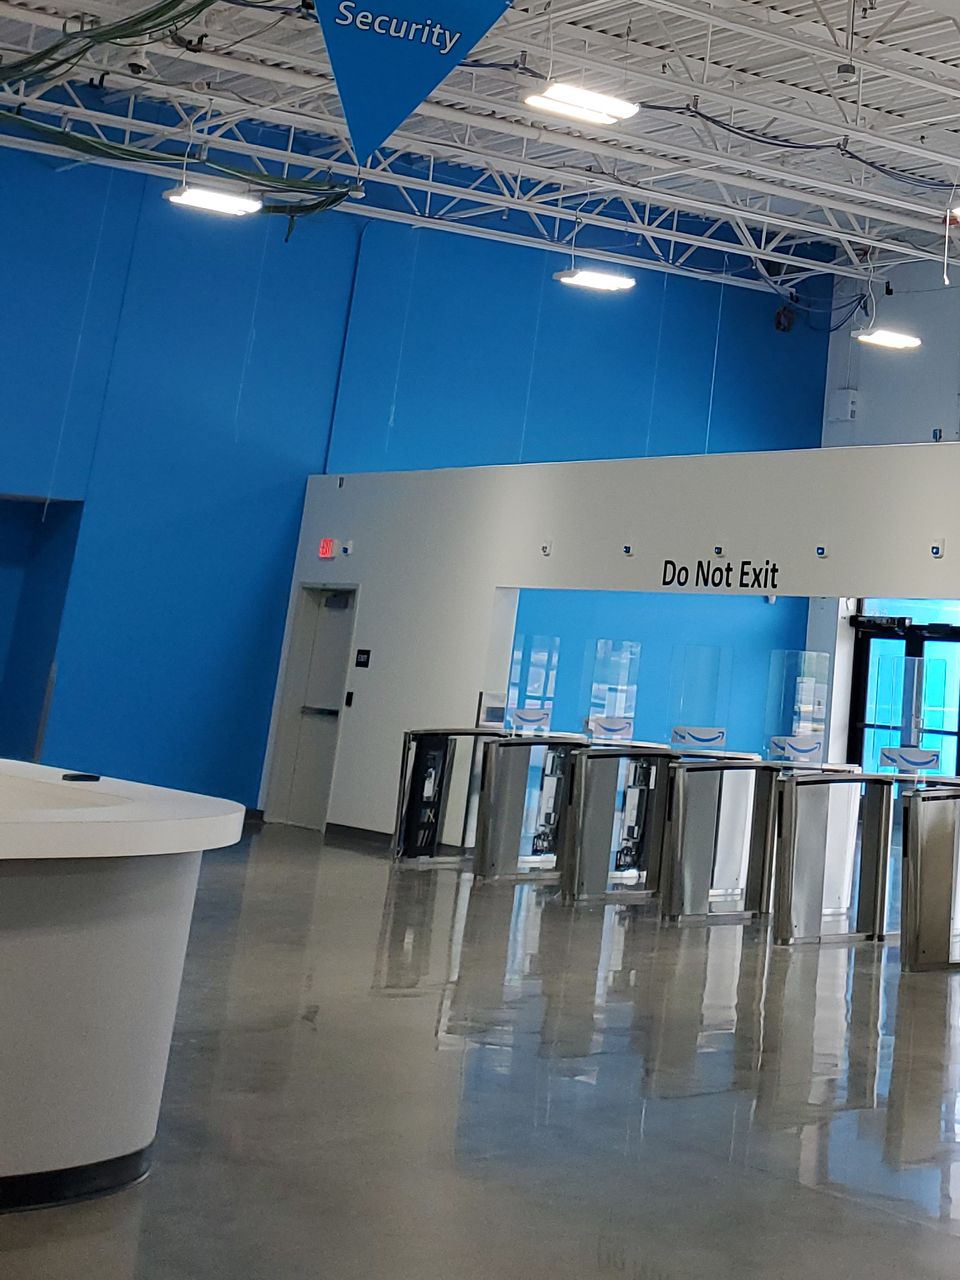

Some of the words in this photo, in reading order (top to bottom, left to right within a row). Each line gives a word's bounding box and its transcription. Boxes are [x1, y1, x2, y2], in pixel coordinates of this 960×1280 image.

[335, 1, 461, 54] Security
[662, 560, 689, 587] Do
[695, 560, 733, 588] Not
[739, 560, 779, 589] Exit
